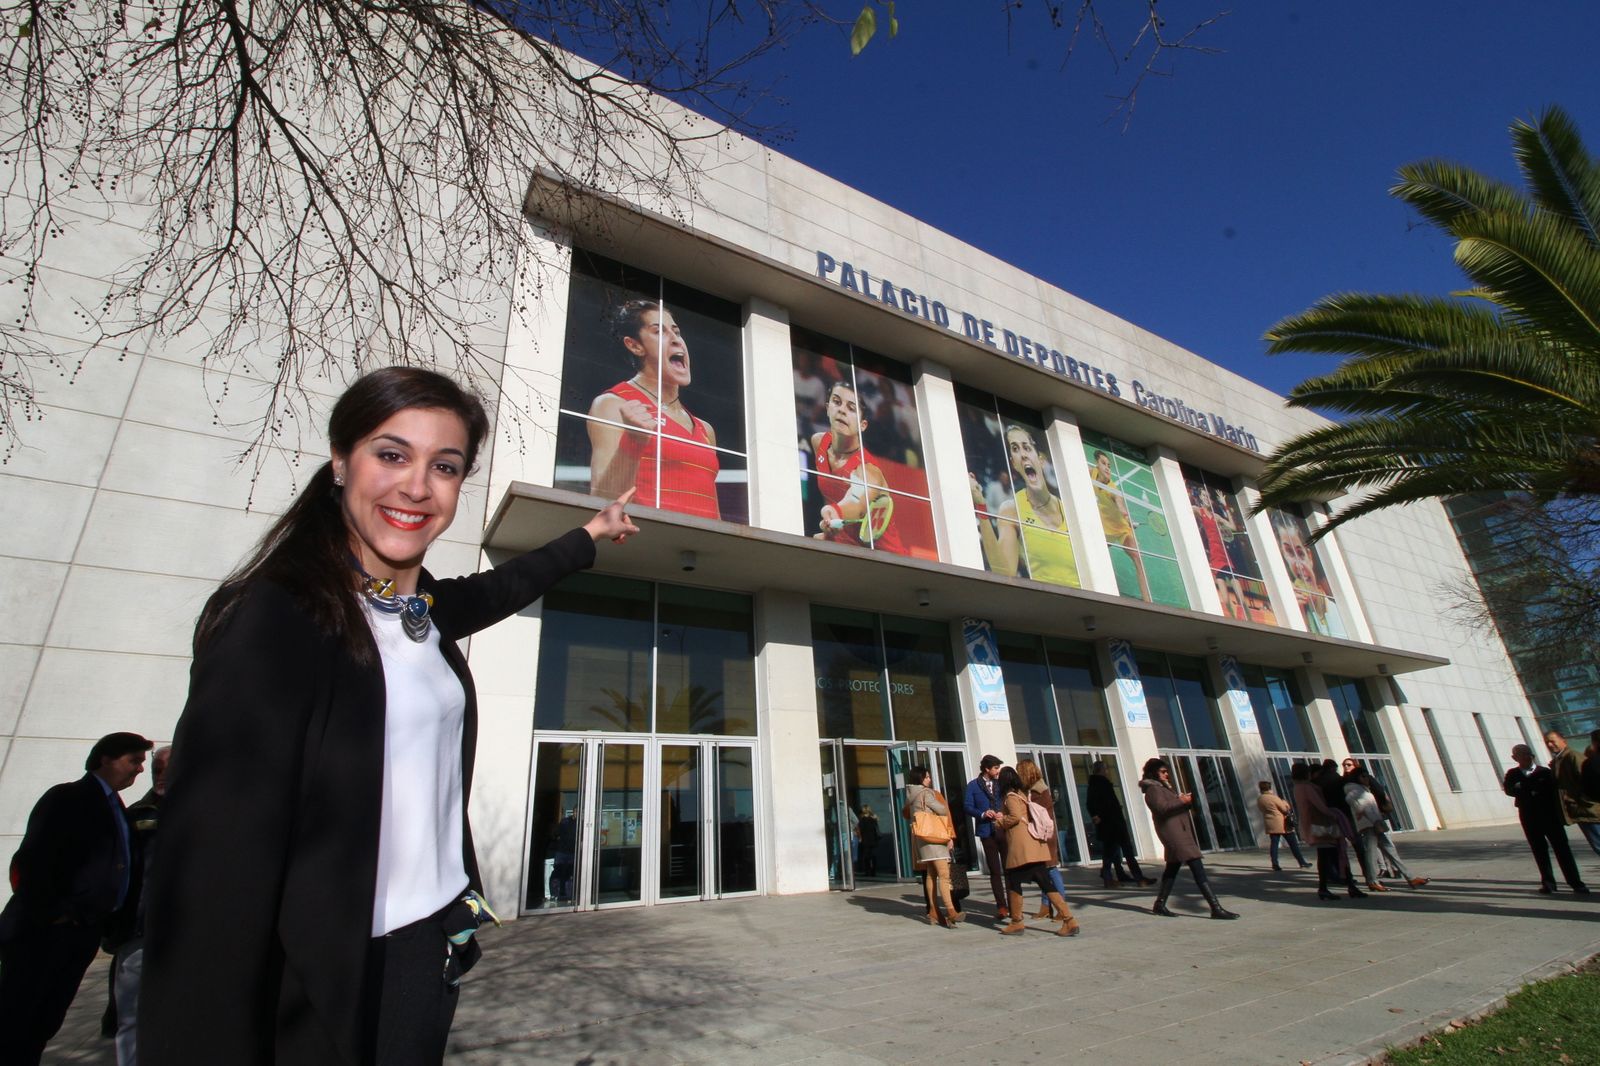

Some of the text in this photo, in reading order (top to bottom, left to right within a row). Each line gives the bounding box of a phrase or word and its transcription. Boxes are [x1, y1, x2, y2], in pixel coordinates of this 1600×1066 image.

[816, 250, 950, 329] PALACIO
[961, 311, 997, 346] DE
[1002, 329, 1121, 397] DEPORTES
[1132, 380, 1211, 433] Carolina
